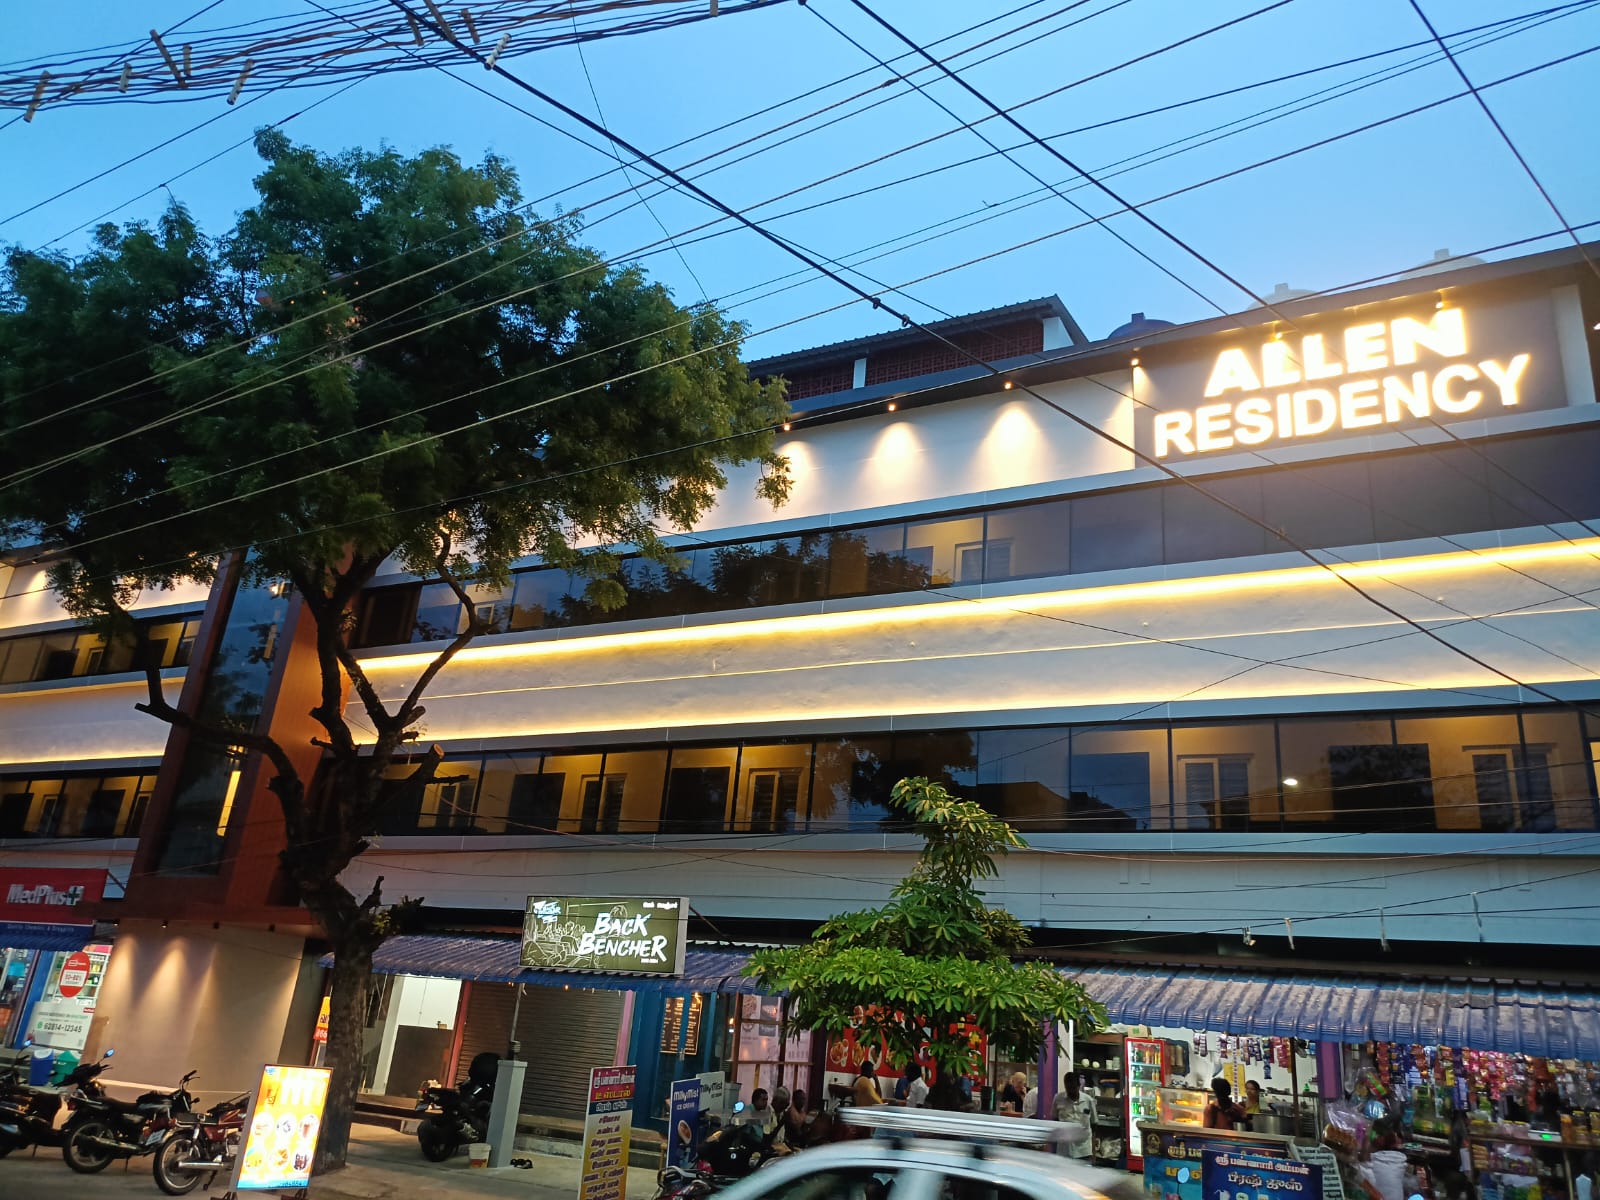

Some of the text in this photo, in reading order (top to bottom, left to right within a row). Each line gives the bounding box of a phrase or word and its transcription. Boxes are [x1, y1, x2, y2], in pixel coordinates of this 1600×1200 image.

[1203, 307, 1469, 398] ALLEN
[1153, 353, 1532, 458] RESIDENCY
[577, 932, 668, 963] BENCHER
[593, 911, 652, 937] BACK
